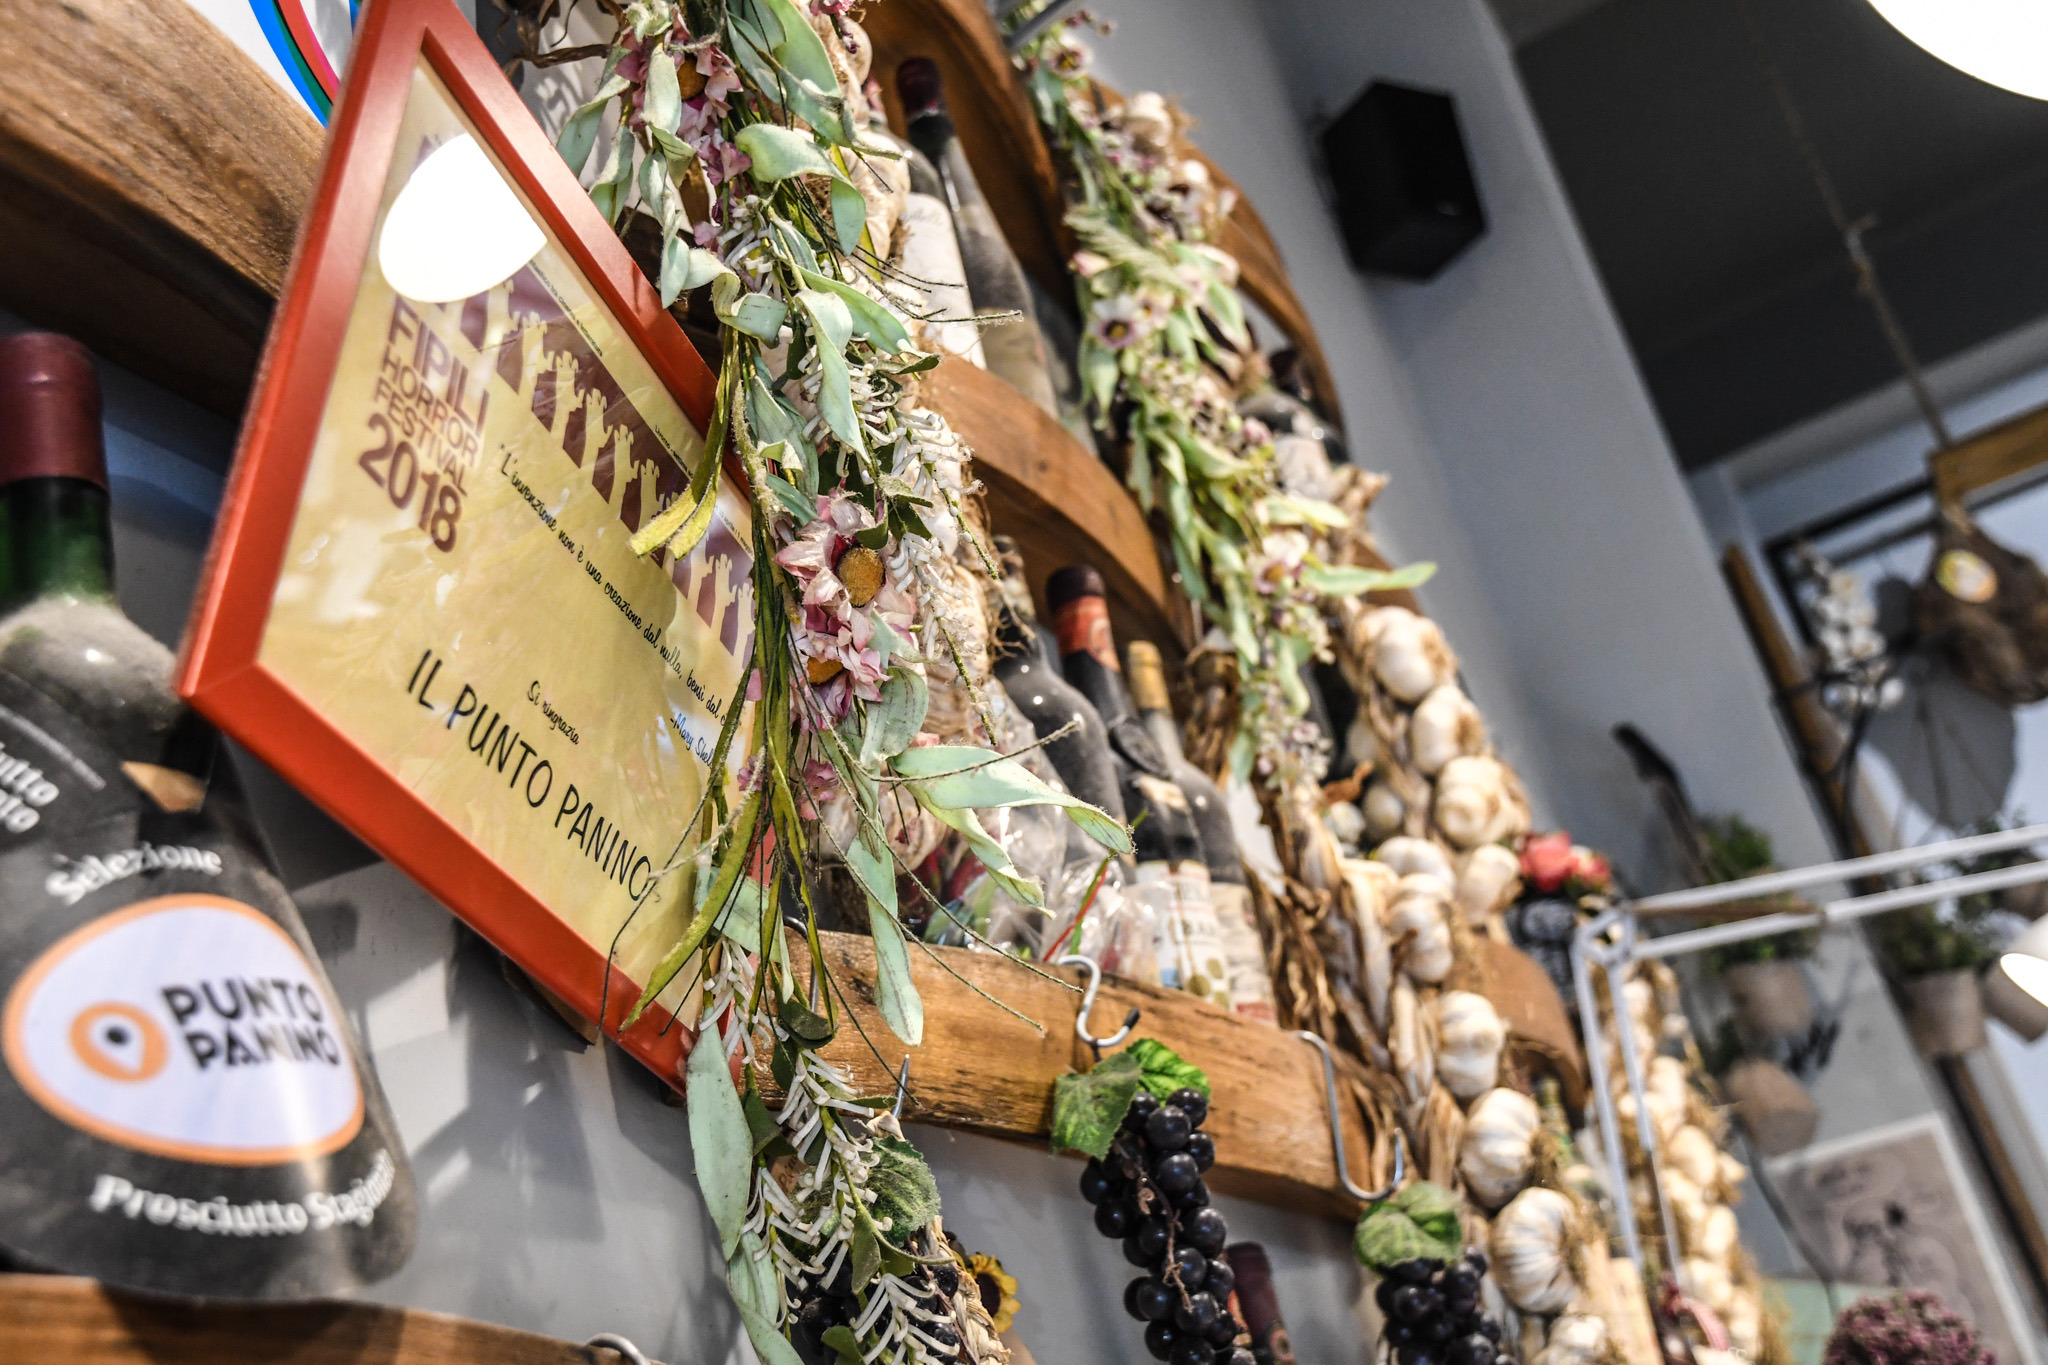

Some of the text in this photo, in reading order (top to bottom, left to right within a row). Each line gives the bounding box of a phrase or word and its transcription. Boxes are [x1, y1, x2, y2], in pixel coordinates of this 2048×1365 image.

[381, 342, 480, 470] HORROR
[388, 292, 490, 440] FIPILI
[358, 411, 463, 554] 2018
[373, 374, 469, 498] FESTIVAL
[558, 529, 575, 554] non
[577, 544, 584, 563] è
[585, 560, 602, 585] una
[604, 581, 642, 630] creazione
[643, 623, 662, 649] dal
[705, 694, 722, 719] dal
[527, 680, 580, 746] Si ringrazia
[406, 649, 652, 902] IL PUNTO PANINO
[45, 841, 224, 905] Selezione
[160, 976, 323, 1026] PUNTO
[185, 1023, 340, 1071] PANINO
[90, 1173, 308, 1236] Prosciutto
